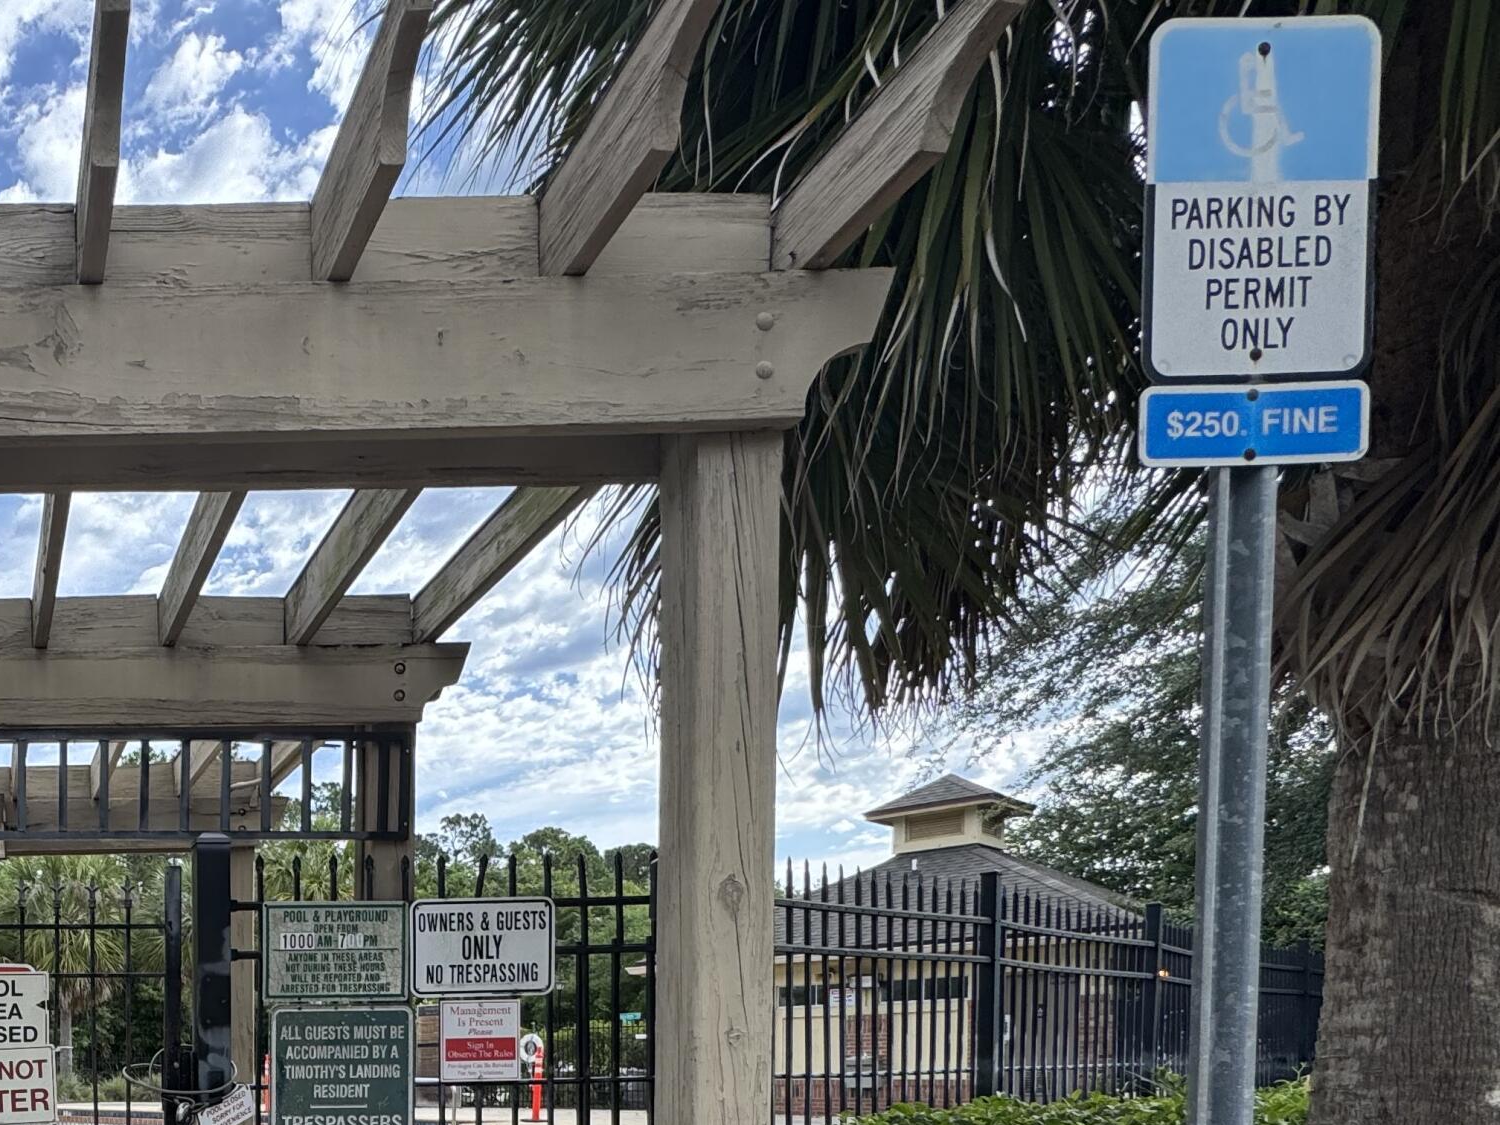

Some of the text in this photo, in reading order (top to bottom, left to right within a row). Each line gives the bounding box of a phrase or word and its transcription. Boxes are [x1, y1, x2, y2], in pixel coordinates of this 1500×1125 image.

[1171, 194, 1350, 229] PARKING BY
[1188, 236, 1332, 270] DISABLED
[1206, 276, 1312, 309] PERMIT
[1221, 317, 1294, 350] ONLY
[1167, 406, 1338, 439] $250. FINE
[283, 910, 388, 924] POOL & PLAYGROUND
[418, 911, 546, 932] OWNERS & GUESTS
[314, 924, 358, 933] OPEN FROM
[462, 935, 502, 960] ONLY
[288, 952, 383, 962] ANYONE IN THESE AREAS
[286, 963, 385, 972] NOT DURING THESE HOURS
[426, 963, 538, 984] NO TRESPASSING
[291, 973, 380, 983] WILL BE REPORTED AND
[281, 983, 390, 993] ARRESTED FOR TRESPASSING
[450, 1006, 511, 1017] Management
[458, 1017, 503, 1027] Is Present
[281, 1025, 404, 1040] ALL GUESTS MUST BE
[286, 1045, 398, 1060] ACCOMPANIED BY A
[467, 1042, 484, 1050] Sign
[284, 1064, 400, 1079] TIMOTHY'S LANDING
[313, 1084, 370, 1098] RESIDENT
[206, 1091, 246, 1117] POOL CLOSED
[212, 1101, 244, 1124] SORRY FOR
